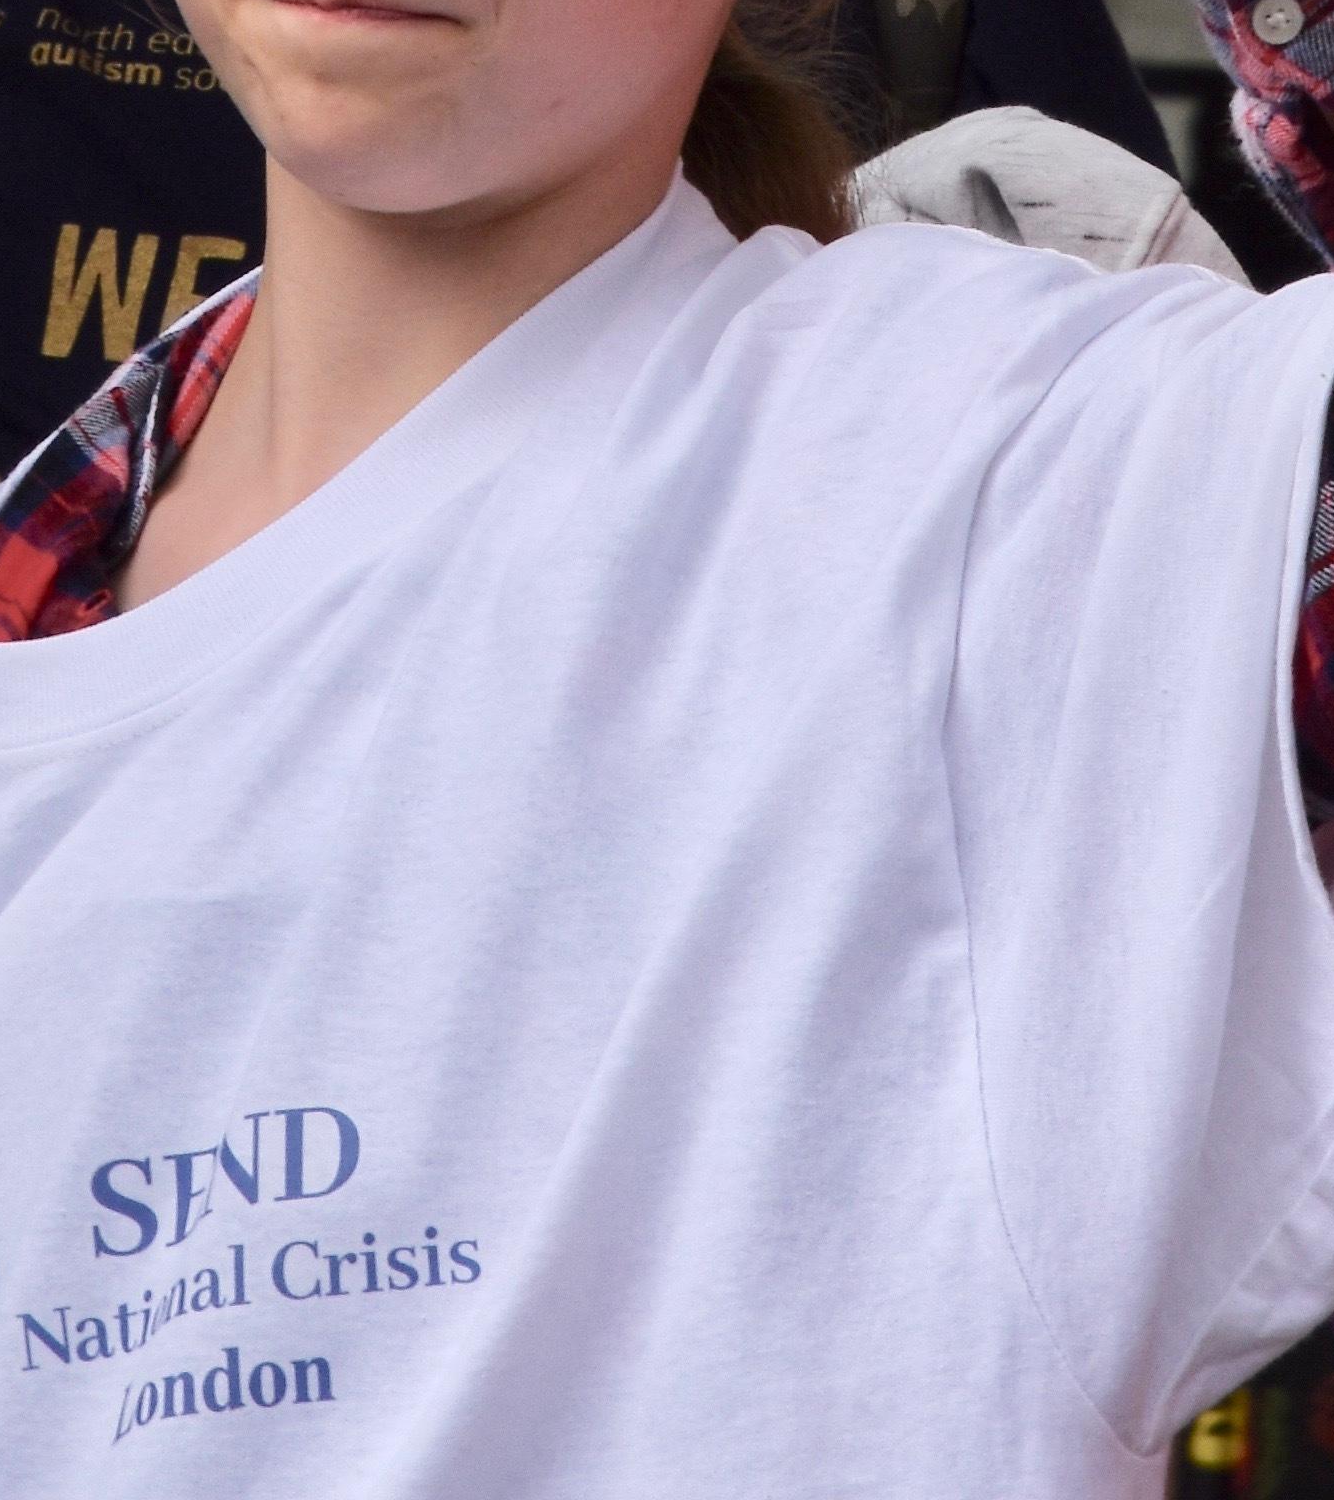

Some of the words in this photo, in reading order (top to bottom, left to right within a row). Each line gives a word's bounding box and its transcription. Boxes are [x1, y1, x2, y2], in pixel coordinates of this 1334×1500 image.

[36, 6, 135, 51] north
[147, 31, 196, 56] ea
[29, 41, 163, 87] autism
[270, 1226, 482, 1302] Crisis
[112, 1346, 337, 1445] London
